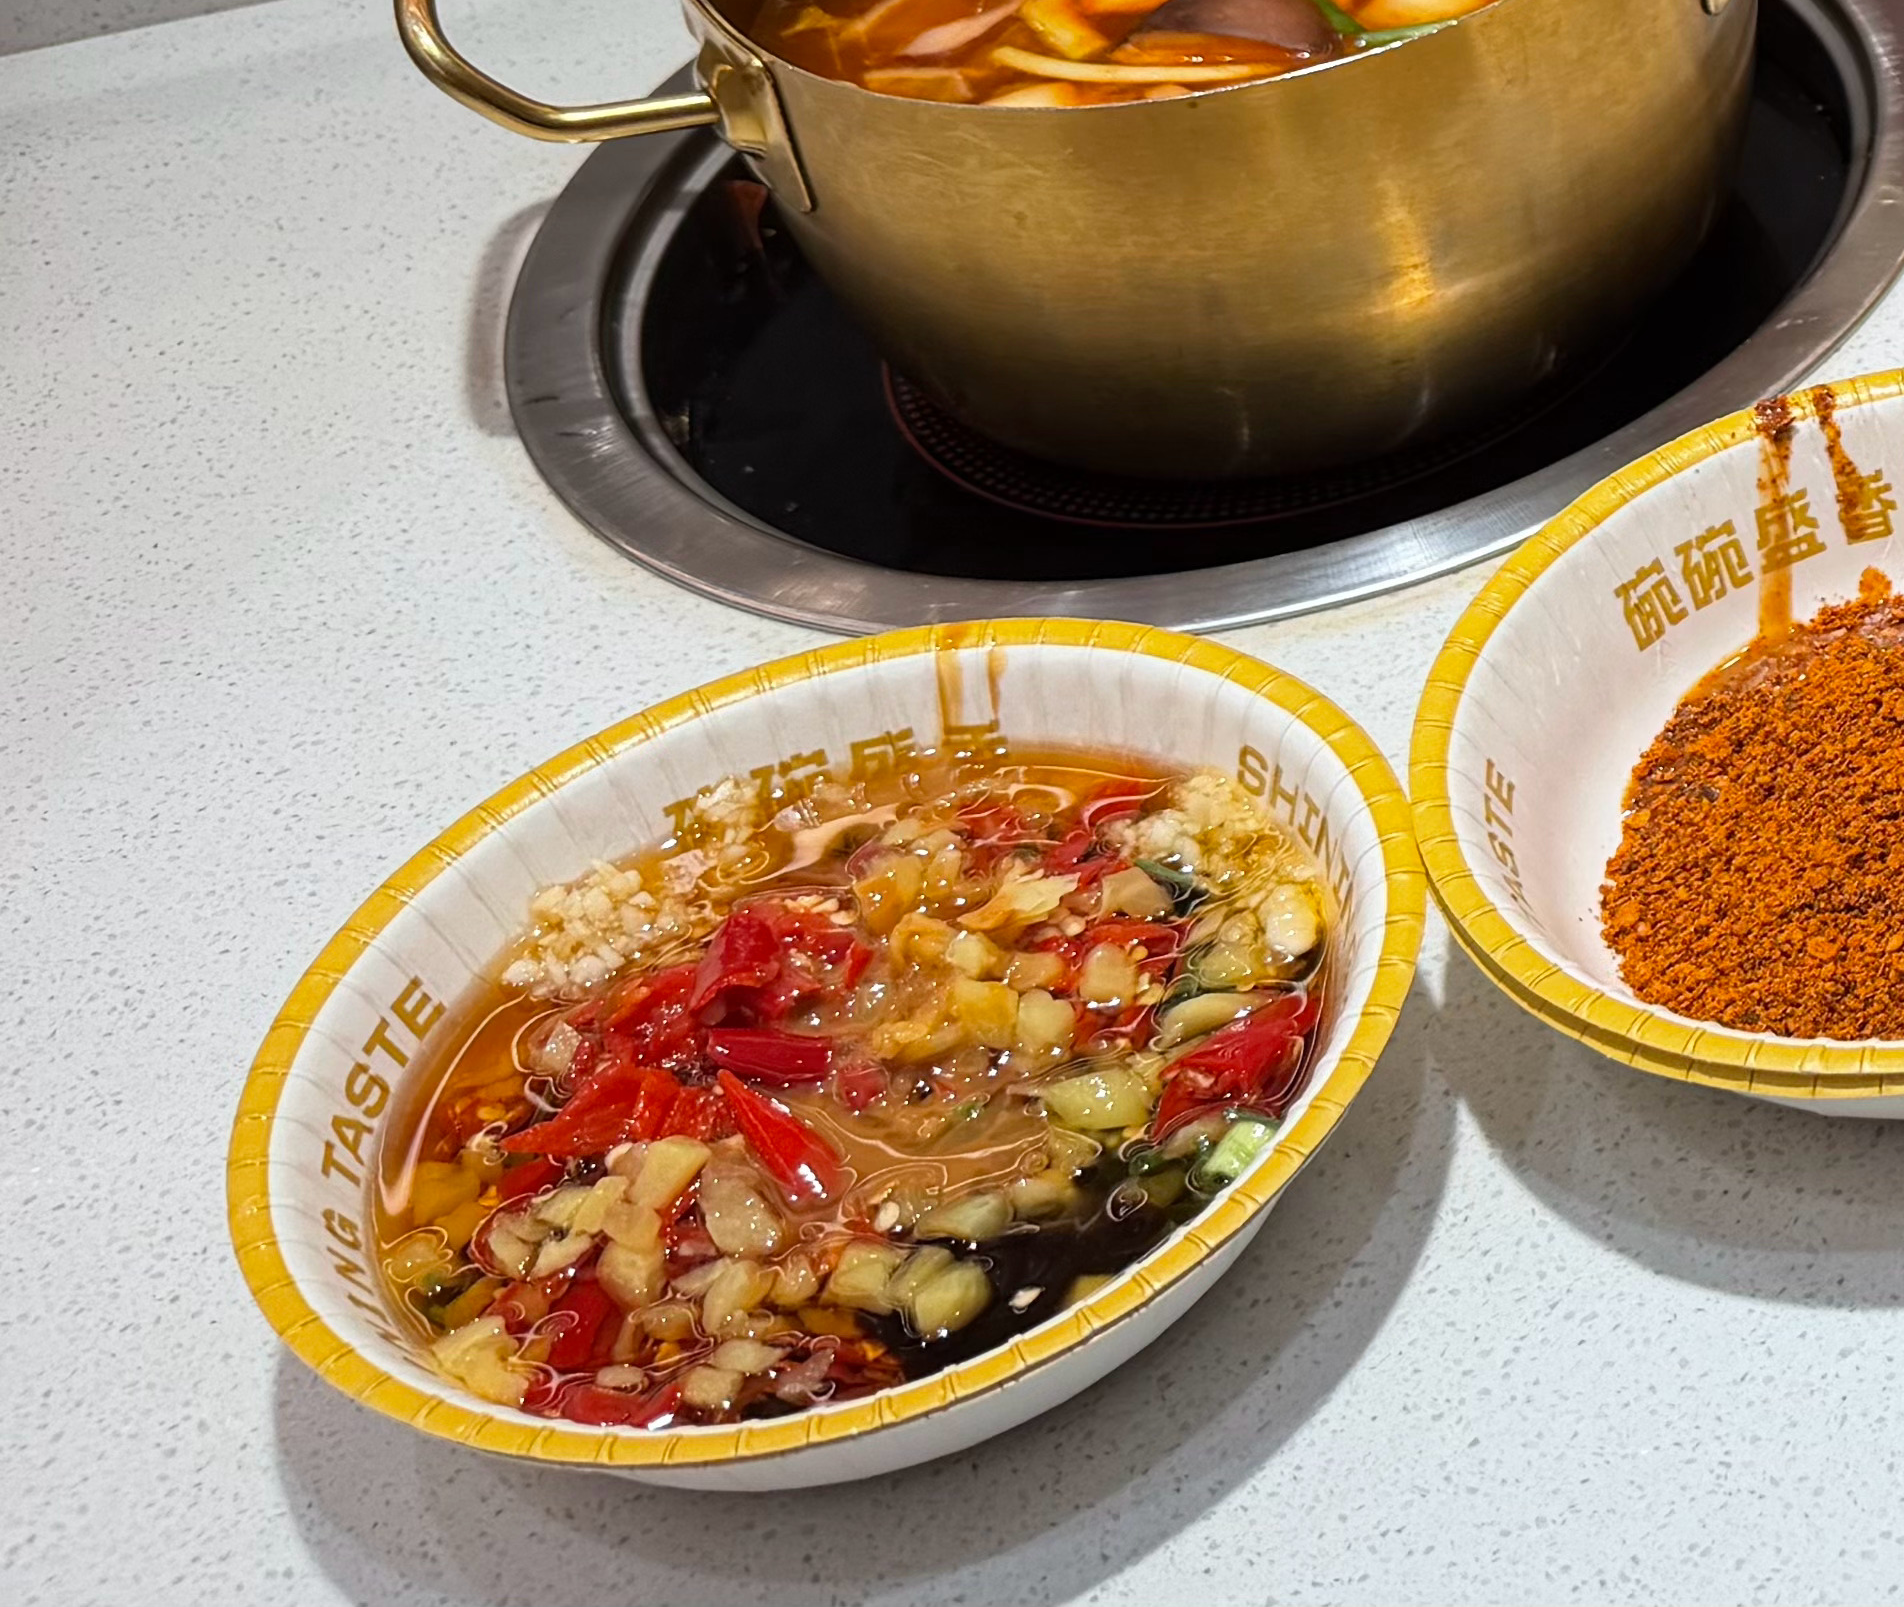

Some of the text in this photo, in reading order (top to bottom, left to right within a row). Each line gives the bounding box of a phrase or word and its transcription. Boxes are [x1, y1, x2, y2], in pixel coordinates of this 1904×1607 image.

[1613, 468, 1898, 652] 碗碗盛香
[320, 974, 446, 1188] TASTE
